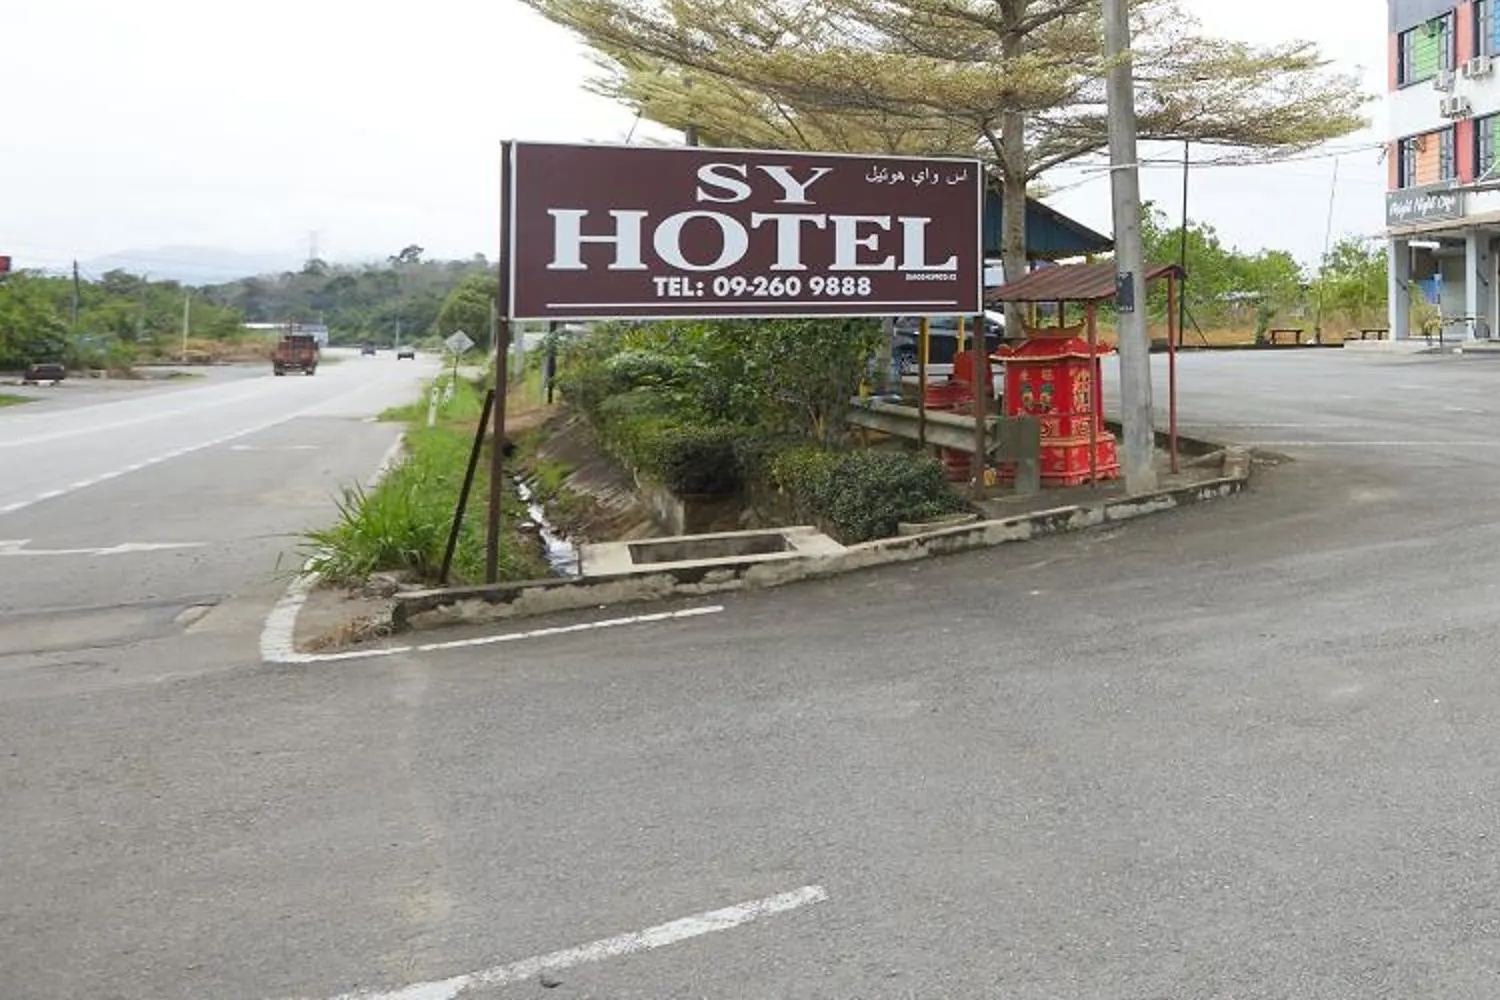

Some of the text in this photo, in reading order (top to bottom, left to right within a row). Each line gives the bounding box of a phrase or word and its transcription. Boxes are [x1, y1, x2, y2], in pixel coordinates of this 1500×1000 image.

[696, 162, 833, 206] SY
[546, 208, 958, 272] HOTEL
[653, 275, 872, 297] TEL: 09-260 9888
